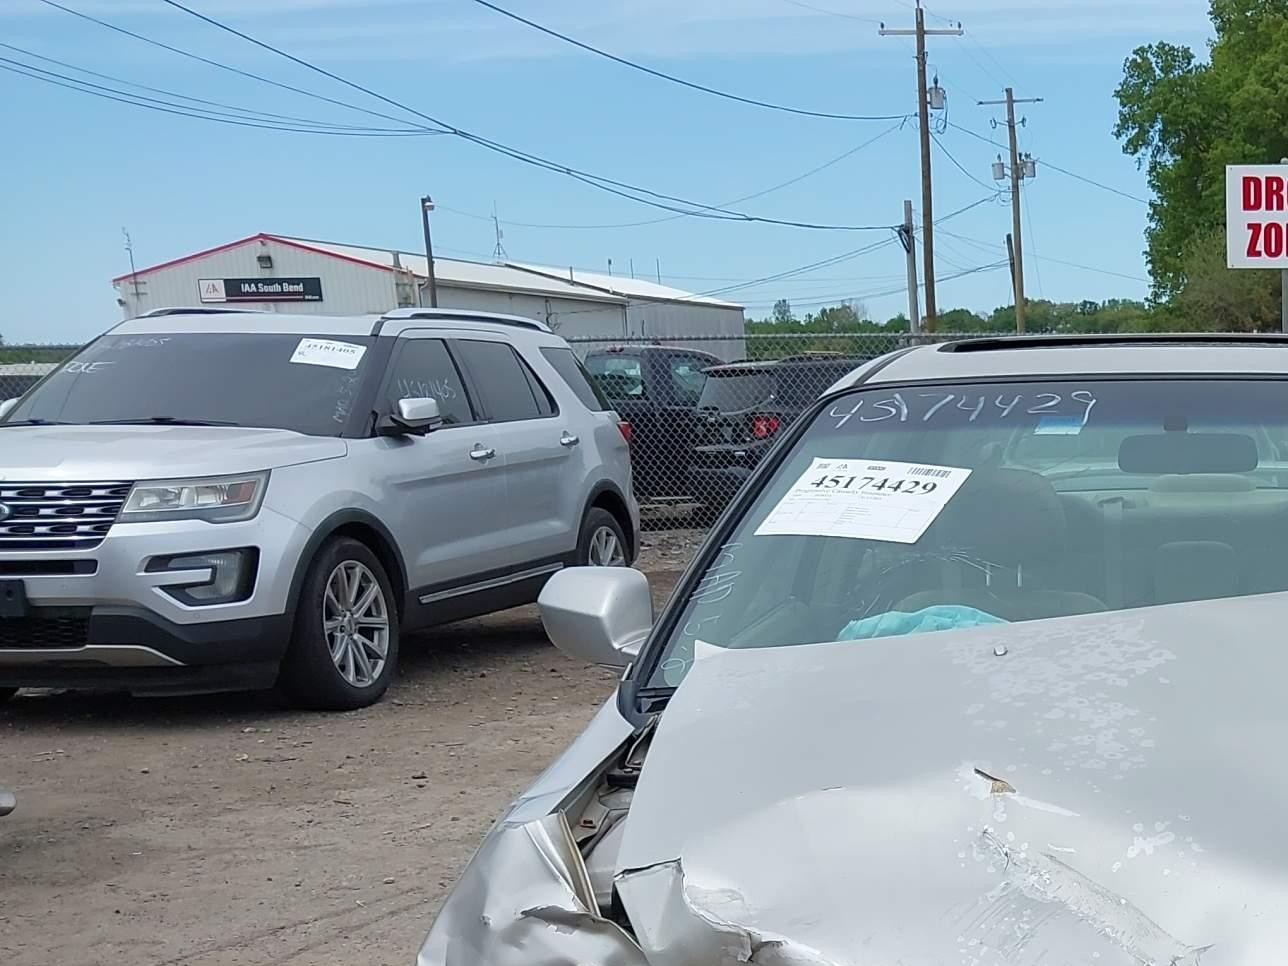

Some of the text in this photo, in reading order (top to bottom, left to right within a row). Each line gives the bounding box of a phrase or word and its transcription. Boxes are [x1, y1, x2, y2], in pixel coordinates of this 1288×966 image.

[241, 282, 304, 293] IAA South Bend
[829, 390, 1097, 429] 45174429
[810, 474, 938, 496] 45174429
